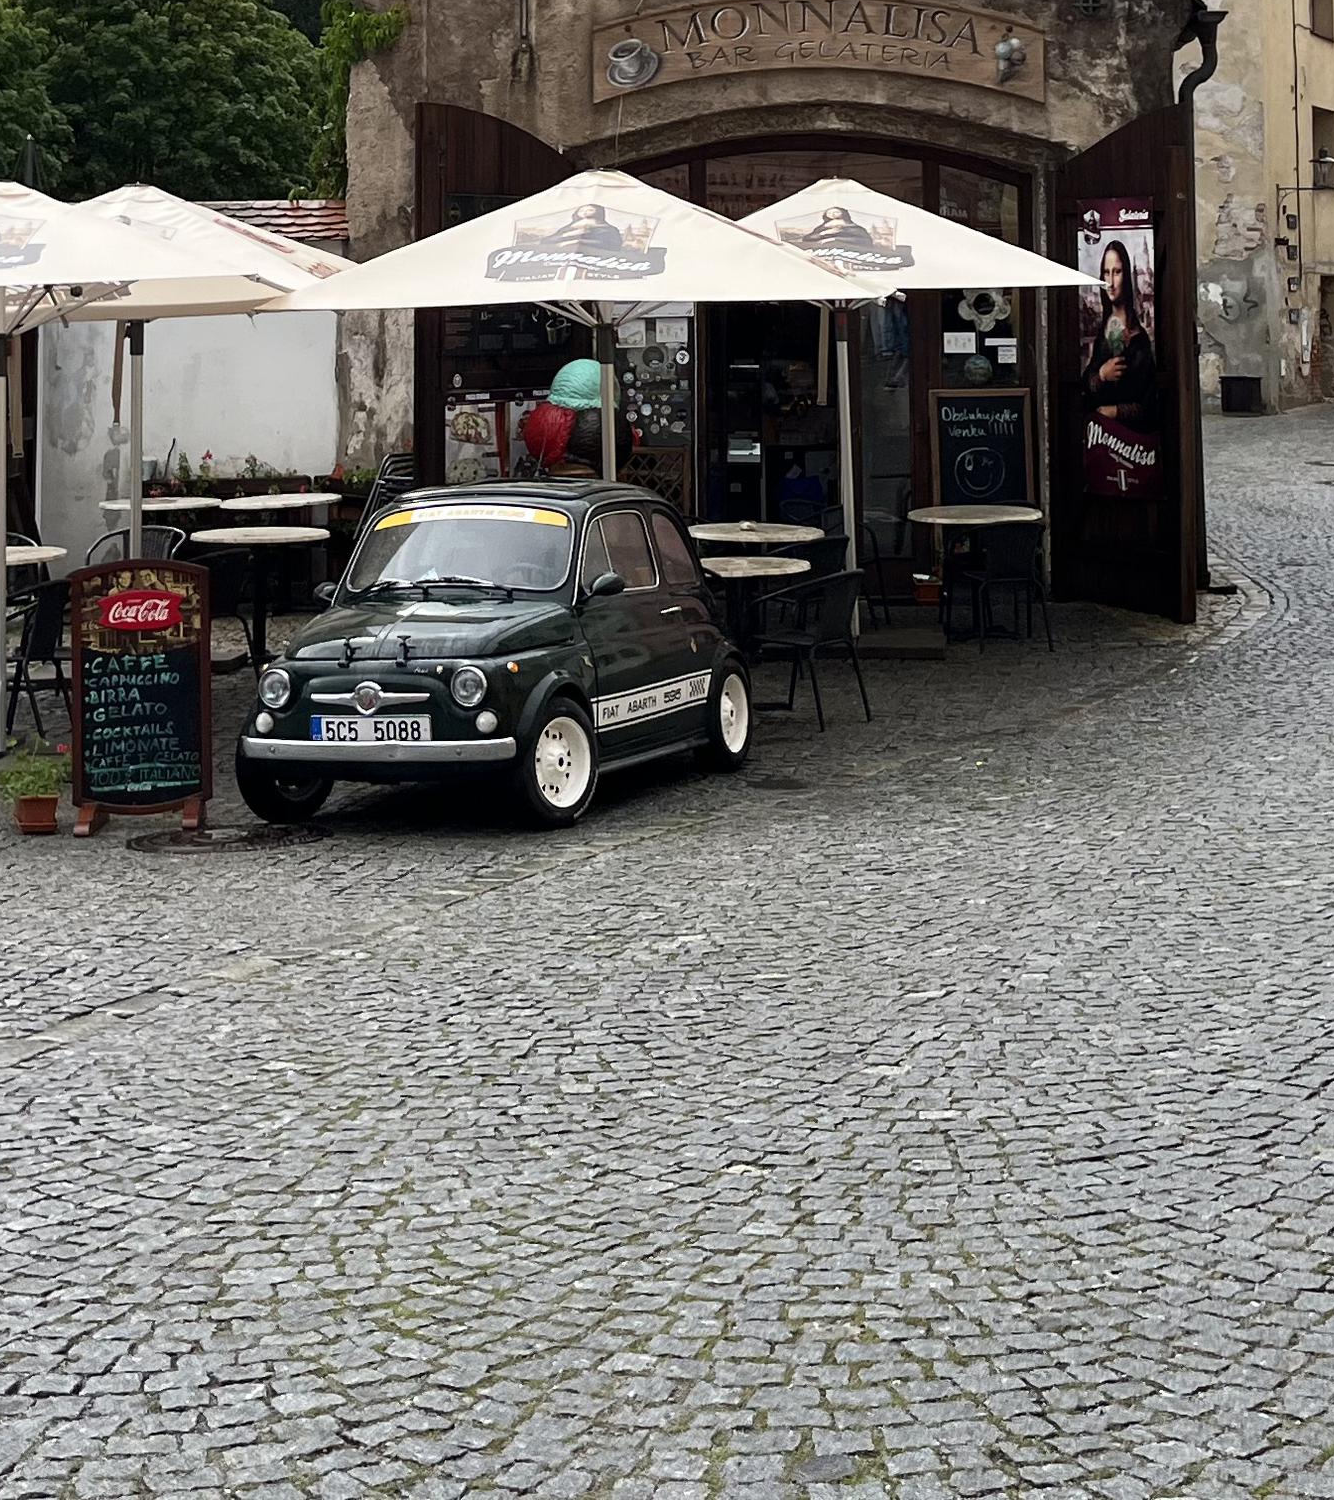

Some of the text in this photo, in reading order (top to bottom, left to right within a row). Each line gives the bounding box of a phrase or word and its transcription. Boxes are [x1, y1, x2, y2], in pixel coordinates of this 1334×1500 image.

[656, 0, 984, 57] MONNALISA
[686, 40, 952, 70] BAR GELATERIA
[492, 249, 652, 272] Monnalisa
[1086, 420, 1156, 466] Monnalisa
[108, 598, 171, 624] Coca-Cola
[88, 672, 180, 688] CAPPUCCINO
[90, 687, 140, 704] BIRRA
[93, 702, 167, 722] GELATO
[602, 704, 620, 721] FIAT
[627, 695, 657, 714] ABARTH
[92, 721, 174, 740] COCKTAILS
[325, 720, 422, 741] 5C5 5088
[92, 737, 181, 757] LIMONATE
[154, 750, 199, 763] GELATO
